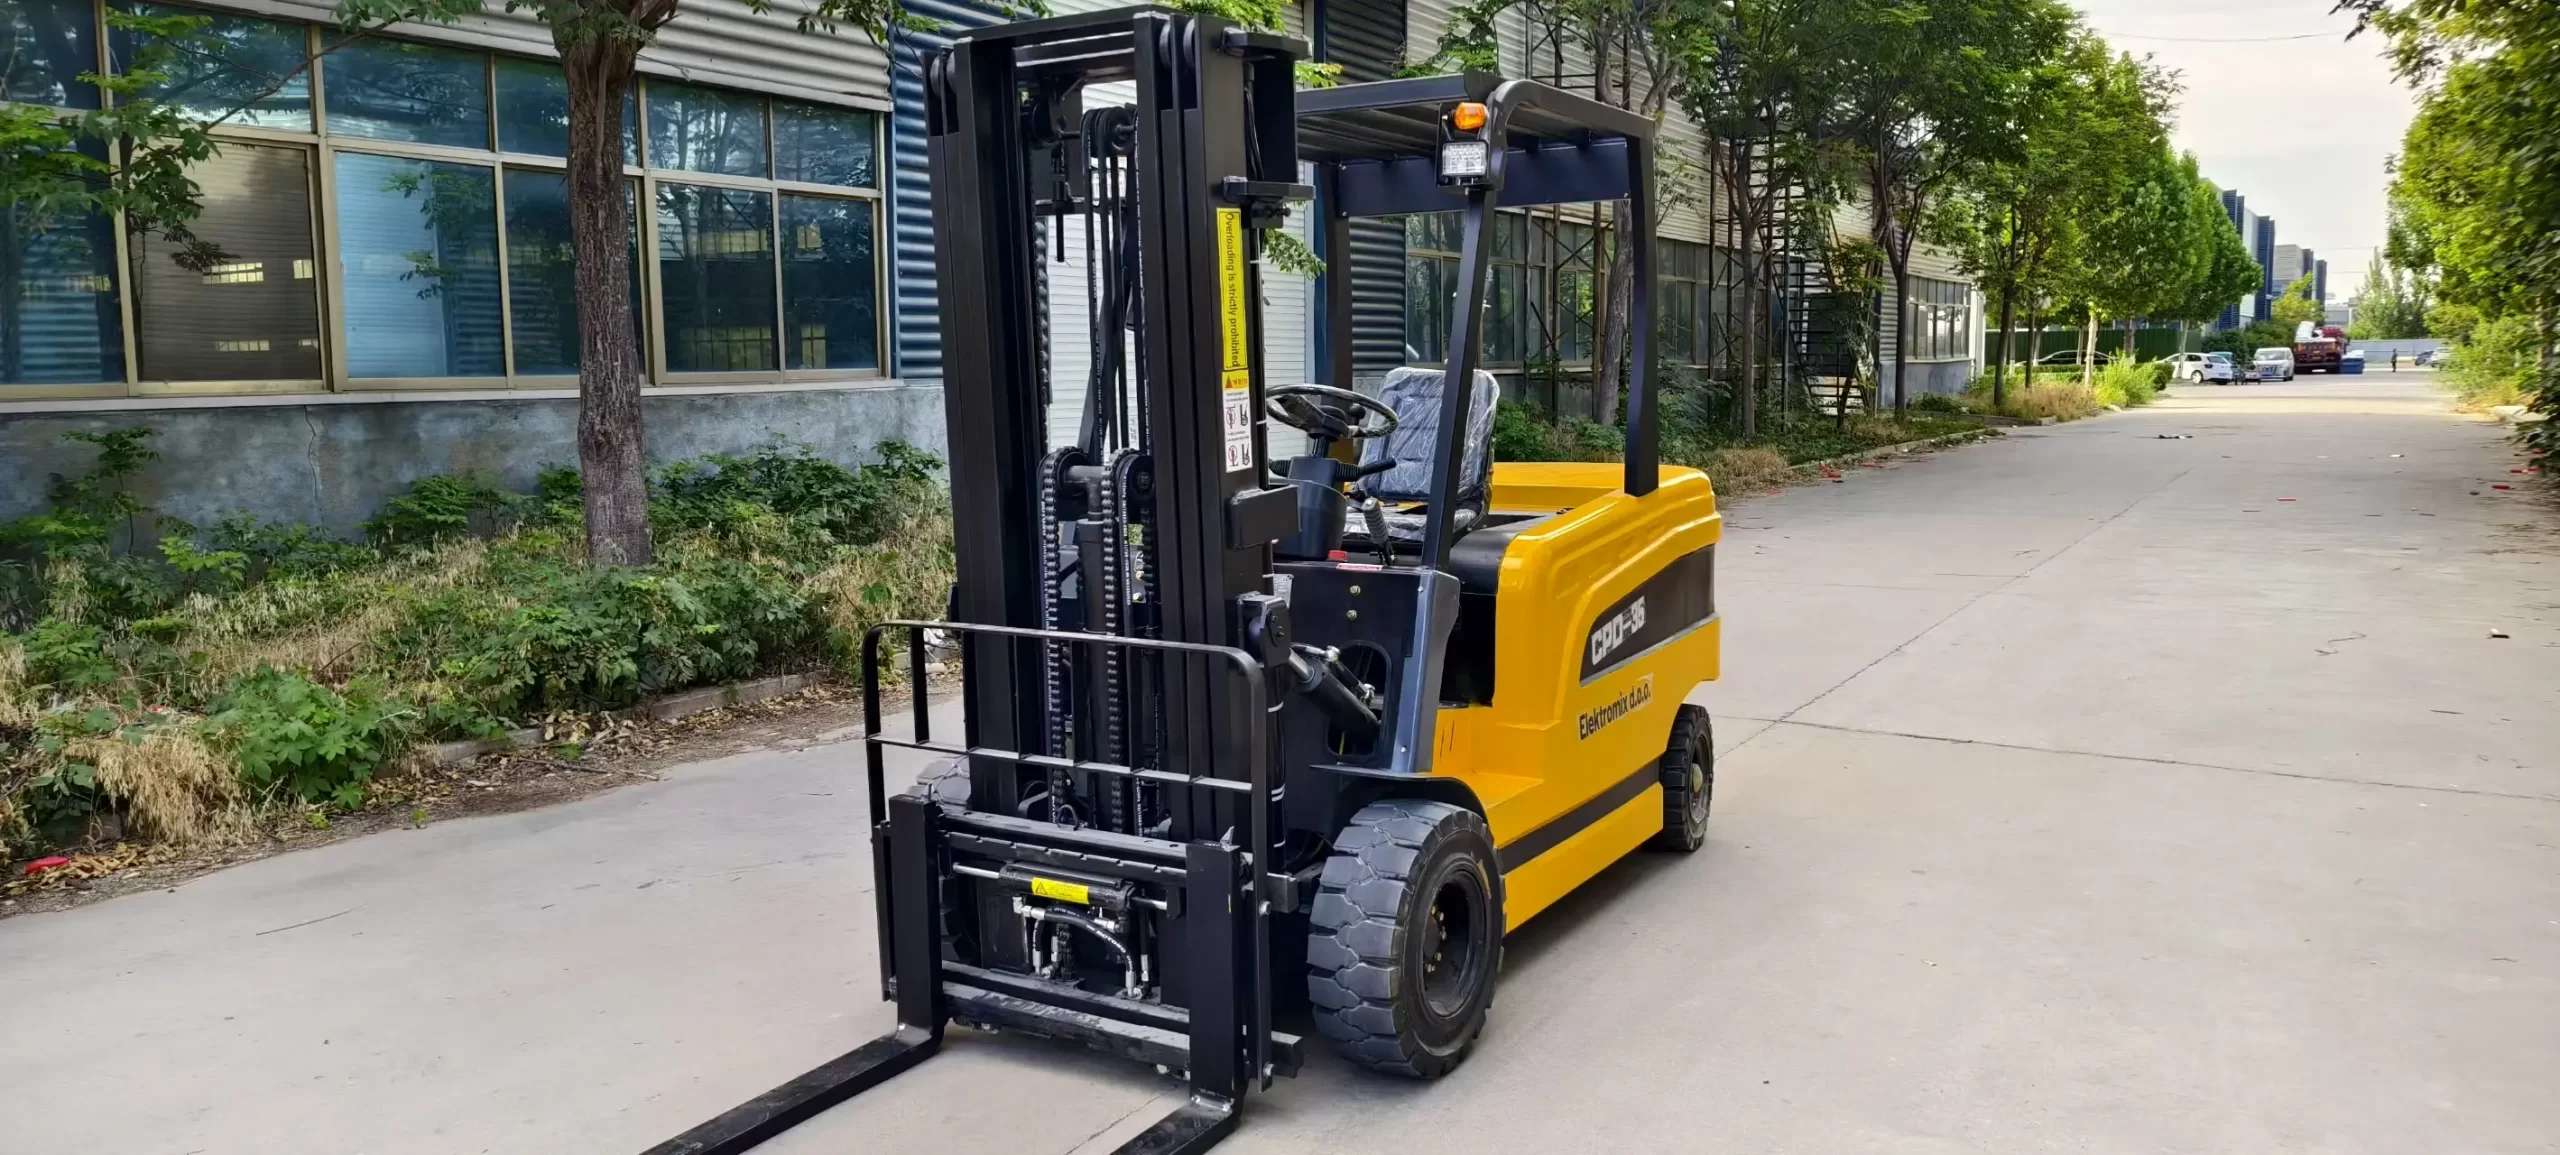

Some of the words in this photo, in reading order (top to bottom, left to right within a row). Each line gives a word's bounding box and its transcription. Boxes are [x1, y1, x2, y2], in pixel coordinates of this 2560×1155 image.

[1225, 212, 1236, 271] Overloading
[1228, 283, 1239, 316] strictly
[1228, 317, 1240, 367] prohibited
[1579, 690, 1628, 741] Elektromix
[1629, 682, 1651, 710] d.o.o.
